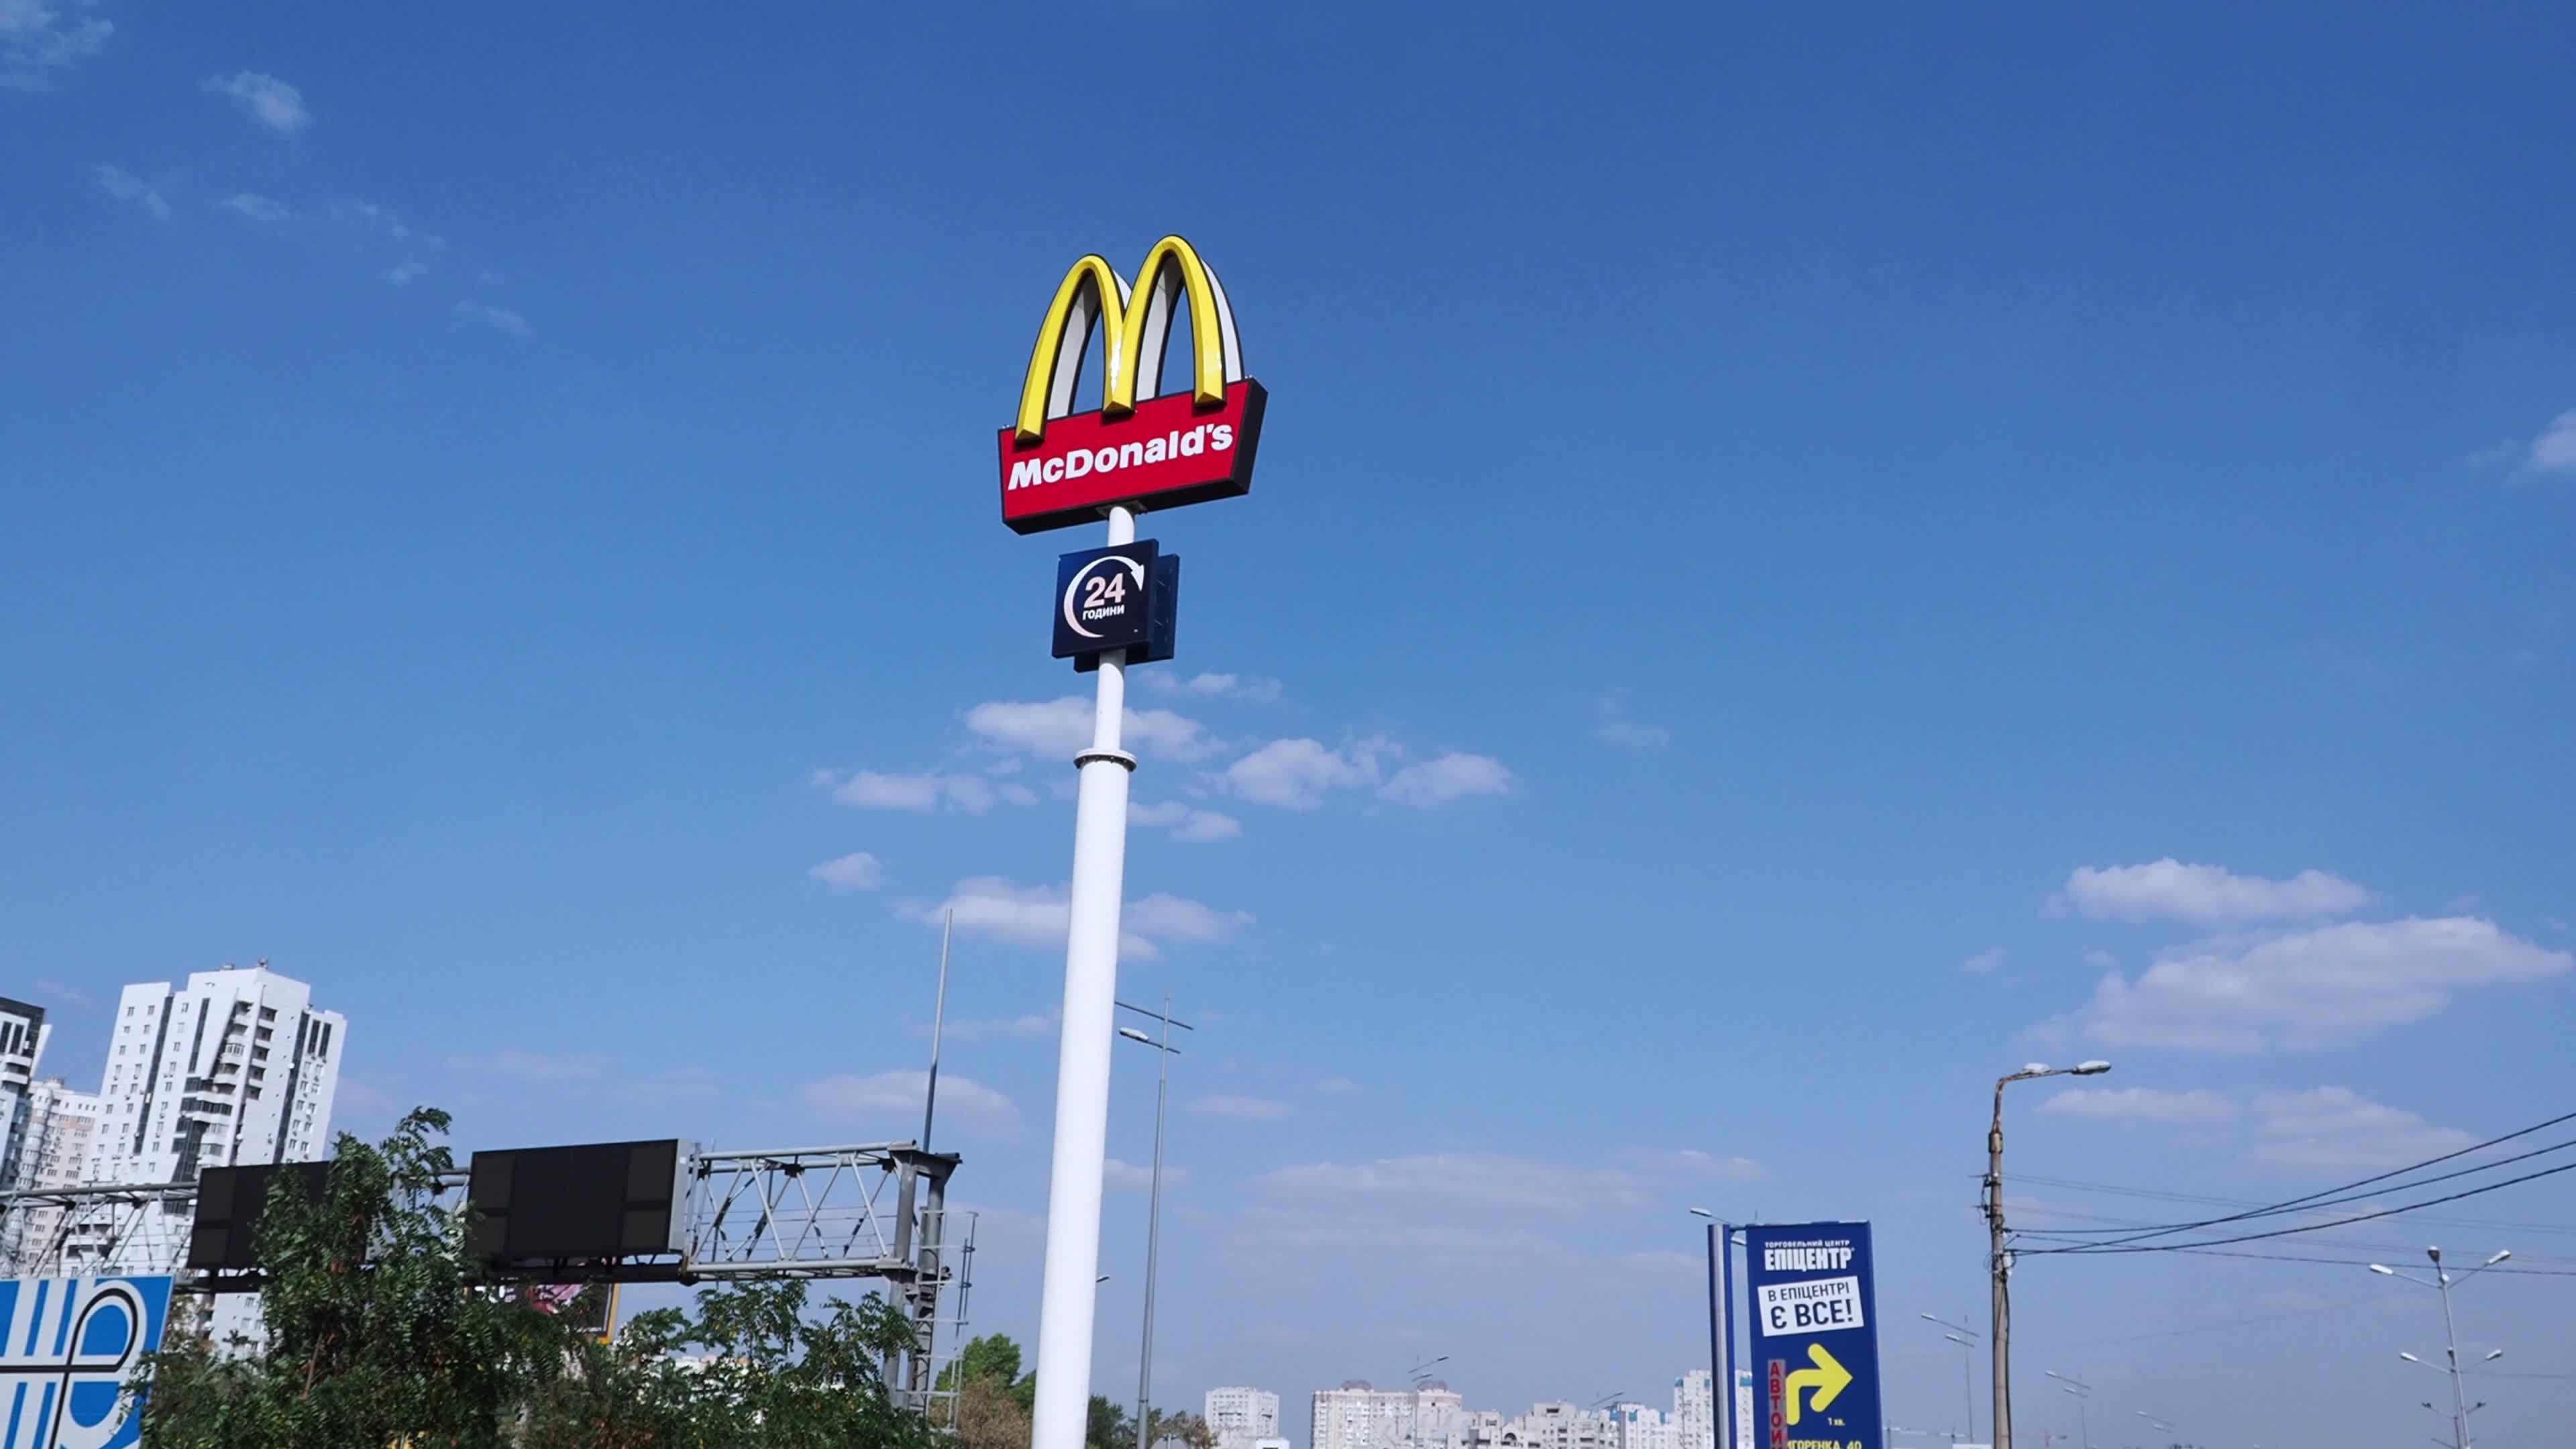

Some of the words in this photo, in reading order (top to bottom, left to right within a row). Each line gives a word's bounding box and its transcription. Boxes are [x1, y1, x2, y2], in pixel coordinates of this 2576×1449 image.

[1008, 423, 1233, 490] McDonald's
[1084, 573, 1126, 608] 24
[1765, 1240, 1823, 1248] ТОРГОВЕЛЬНИЙ
[1764, 1247, 1851, 1272] ЕПІЦЕНТР
[1768, 1290, 1776, 1302] В
[1780, 1282, 1849, 1300] ЕПІЦЕНТРІ
[1770, 1305, 1787, 1330] Є
[1794, 1299, 1854, 1328] ВСЕ!
[1770, 1362, 1782, 1449] АВТОИ
[1827, 1417, 1833, 1426] 1
